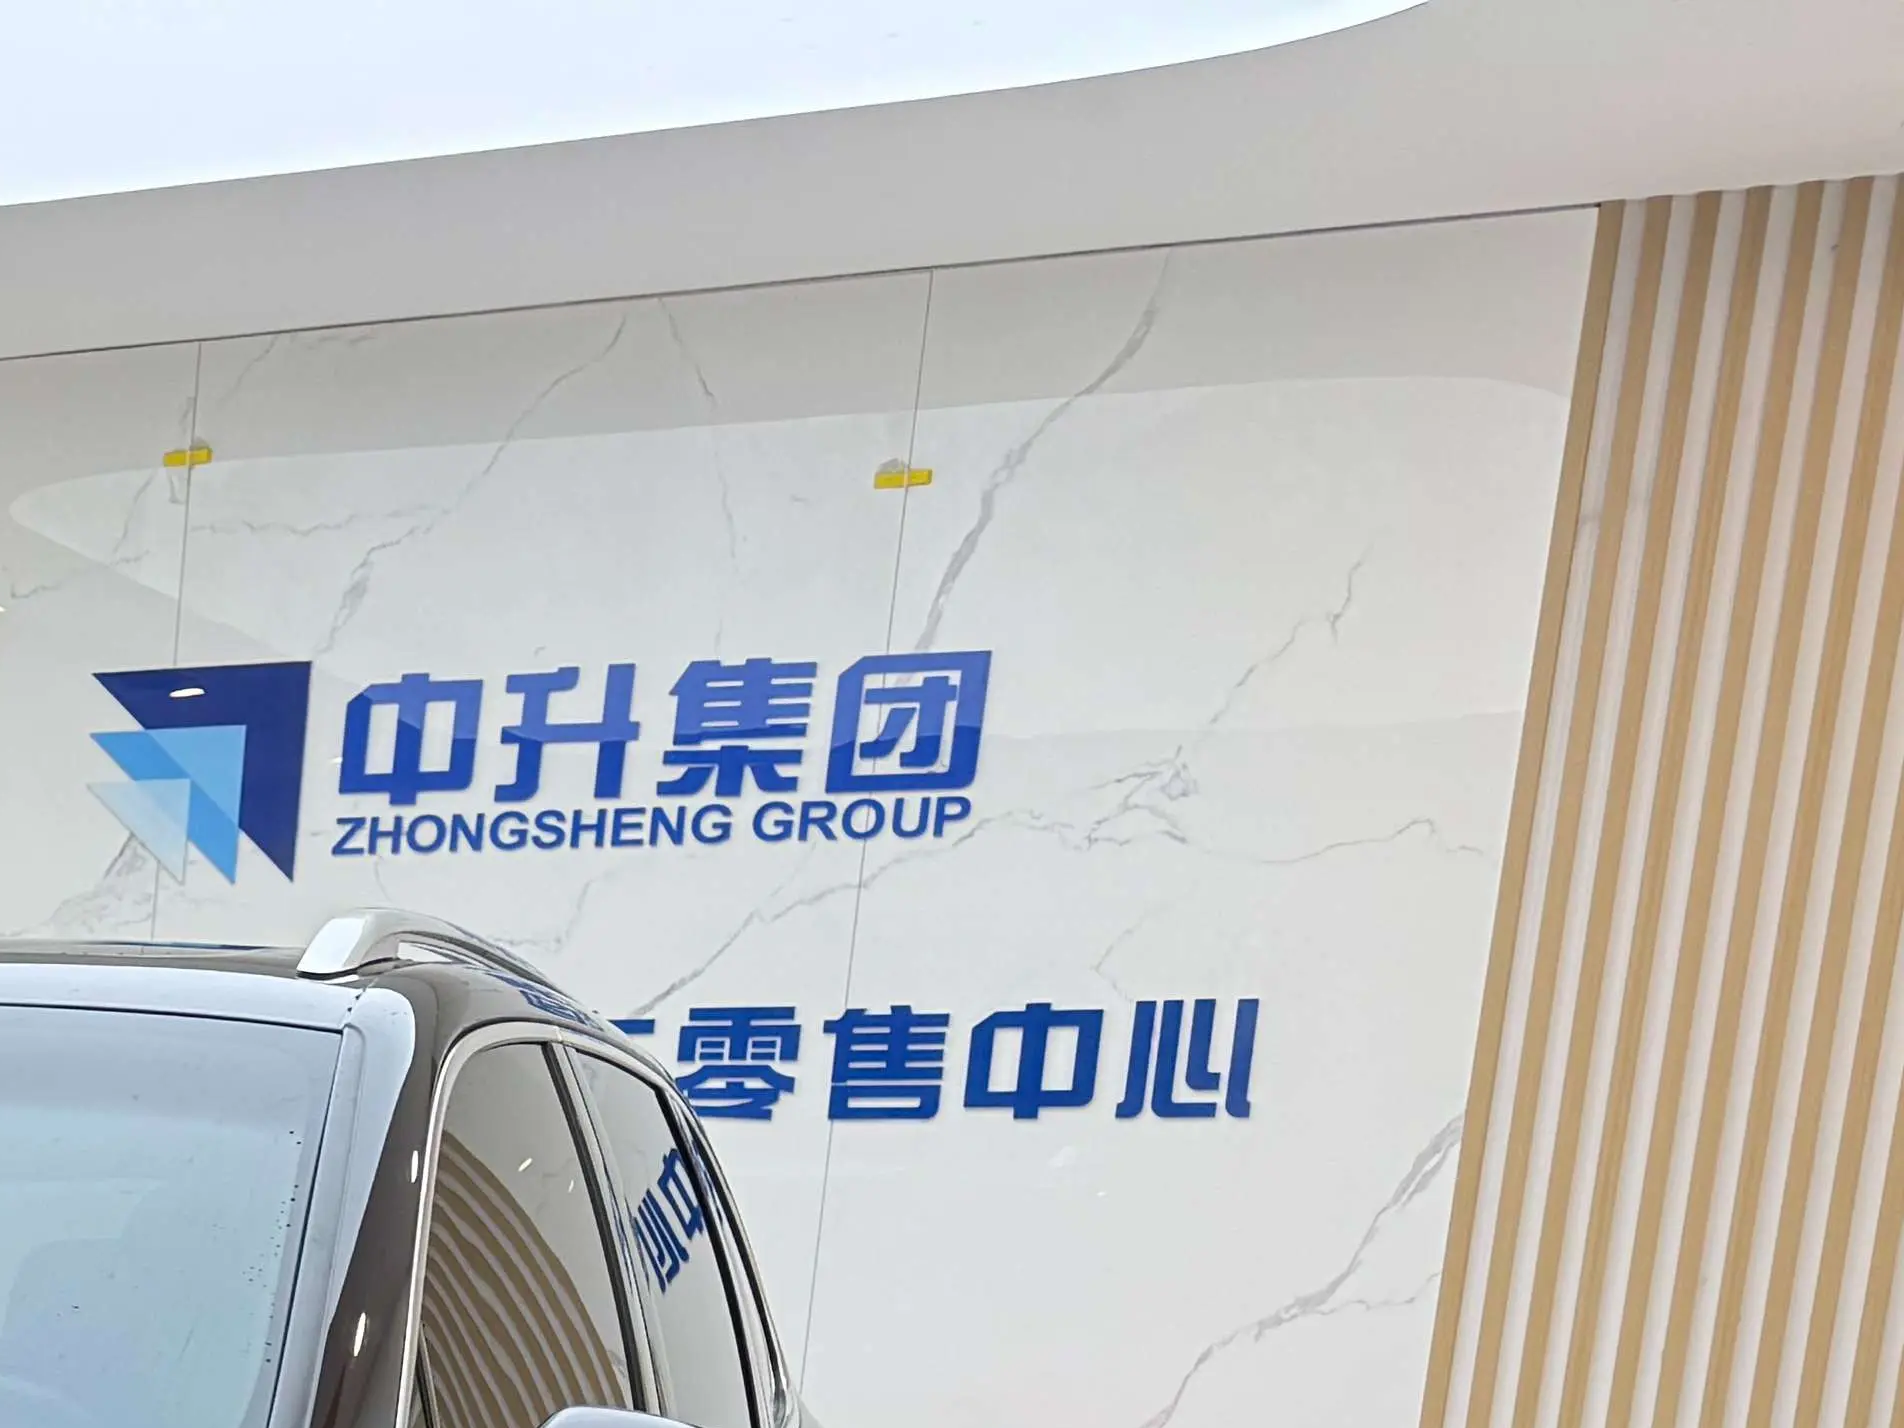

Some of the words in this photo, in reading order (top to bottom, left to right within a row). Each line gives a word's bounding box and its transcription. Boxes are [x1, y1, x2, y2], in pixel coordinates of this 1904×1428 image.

[338, 651, 991, 807] 中升集团
[332, 801, 732, 857] ZHONGSHENG
[753, 796, 973, 843] GROUP
[607, 999, 1259, 1122] 零售中心
